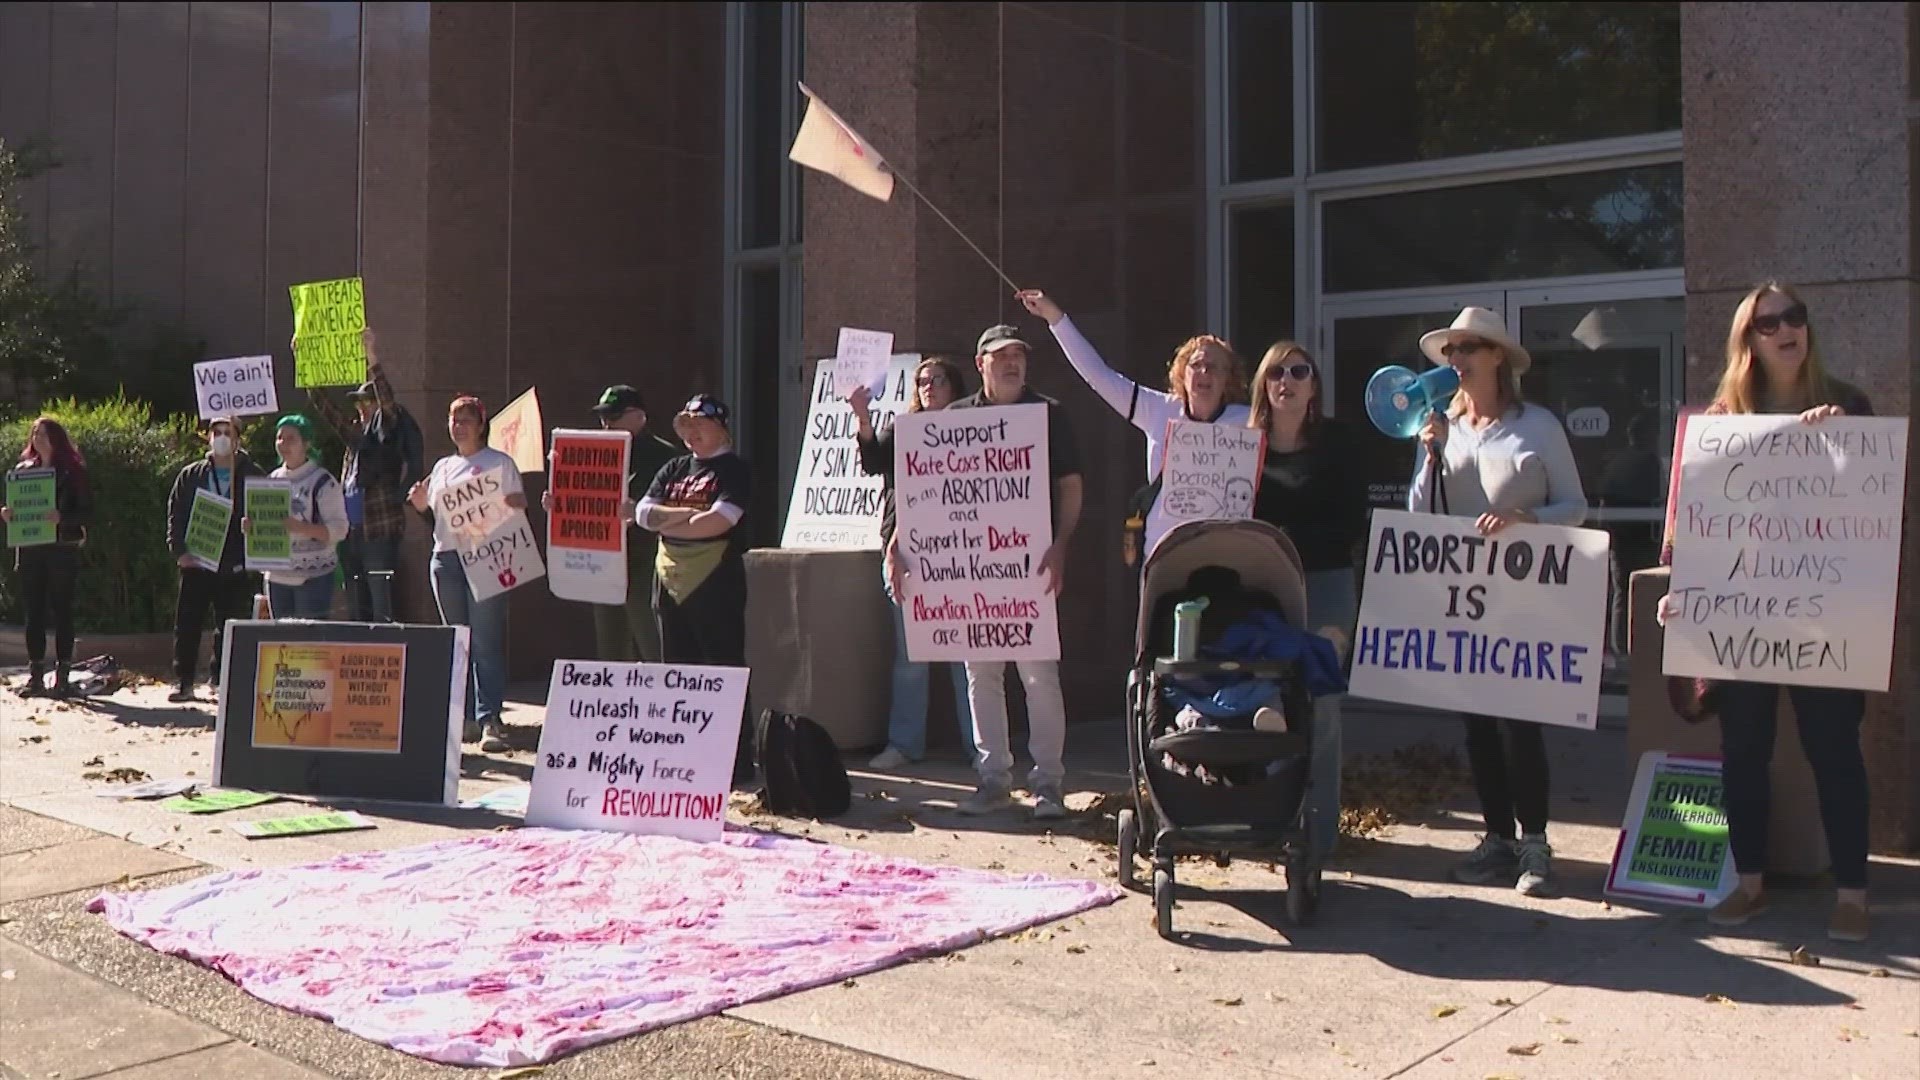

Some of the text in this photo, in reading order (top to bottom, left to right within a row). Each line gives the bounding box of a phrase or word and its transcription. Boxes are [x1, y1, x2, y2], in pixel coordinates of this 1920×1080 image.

[320, 280, 362, 304] TREATS
[301, 303, 363, 334] WOMEN AS
[196, 361, 272, 386] We ain't
[896, 369, 905, 401] A
[208, 388, 267, 411] Gilead
[923, 418, 1008, 448] Support
[1172, 423, 1205, 445] Ken
[1572, 417, 1601, 432] EXIT
[1698, 421, 1896, 461] GOVERNMENT
[561, 447, 619, 468] ABORTION
[810, 448, 822, 477] Y
[824, 447, 848, 478] SIN
[906, 450, 945, 477] Kate
[984, 444, 1035, 473] RIGHT
[1192, 451, 1220, 466] NOT
[1228, 456, 1237, 468] A
[442, 475, 499, 512] BANS
[556, 470, 620, 491] ON DEMAND
[906, 475, 1030, 508] to an ABORTION!
[1172, 469, 1226, 489] DOCTOR!
[1724, 463, 1896, 502] CONTROL OF
[450, 501, 490, 528] OFF
[555, 495, 618, 517] & WITHOUT
[804, 486, 885, 517] DISCULPAS!
[948, 507, 979, 522] and
[560, 519, 611, 541] APOLOGY
[1687, 502, 1893, 543] REPRODUCTION
[462, 527, 531, 567] BODY!
[796, 529, 868, 546] revcom.us
[909, 525, 1031, 553] Support her Doctor
[919, 553, 1031, 582] Damla Karsan!
[1374, 526, 1574, 585] ABORTION
[1728, 548, 1847, 584] ALWAYS
[913, 592, 1040, 622] Abortion Providers
[1445, 584, 1486, 620] IS
[1673, 587, 1824, 624] TORTURES
[932, 622, 1034, 649] are HEROES!
[1708, 627, 1848, 672] WOMEN
[341, 655, 384, 666] ABORTION
[387, 656, 400, 667] ON
[1358, 626, 1588, 684] HEALTHCARE
[340, 669, 400, 680] DEMAND AND
[349, 681, 388, 693] WITHOUT
[562, 663, 724, 692] Break the Chains
[569, 696, 713, 734] Unleash the Fury
[596, 723, 685, 744] of Women
[567, 756, 577, 769] a
[588, 751, 644, 784] Mighty
[652, 758, 695, 783] Force
[566, 786, 723, 822] for REVOLUTION!
[1652, 781, 1723, 807] FORCE
[1639, 835, 1723, 864] FEMALE
[1631, 860, 1718, 882] ENSLAVEMENT
